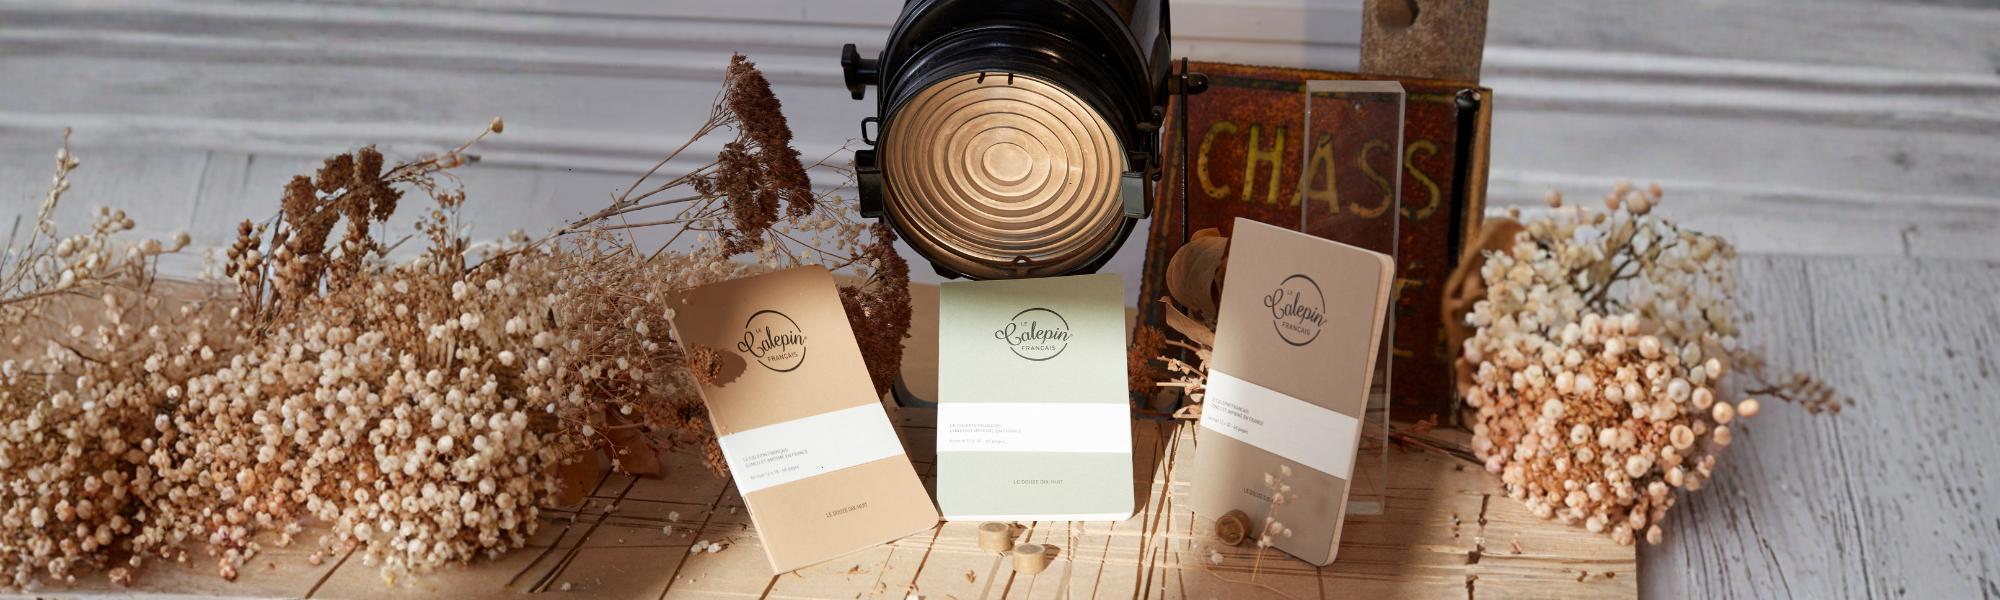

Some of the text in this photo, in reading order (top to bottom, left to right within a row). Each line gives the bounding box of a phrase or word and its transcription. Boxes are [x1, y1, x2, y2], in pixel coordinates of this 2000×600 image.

[1197, 120, 1441, 221] CHASS
[1264, 288, 1325, 327] Calepin
[738, 326, 804, 358] Calepin
[994, 320, 1070, 346] Calepin
[1282, 322, 1310, 336] FRANÇAIS
[767, 351, 798, 362] FRANÇAIS
[1248, 416, 1264, 426] FRANCE
